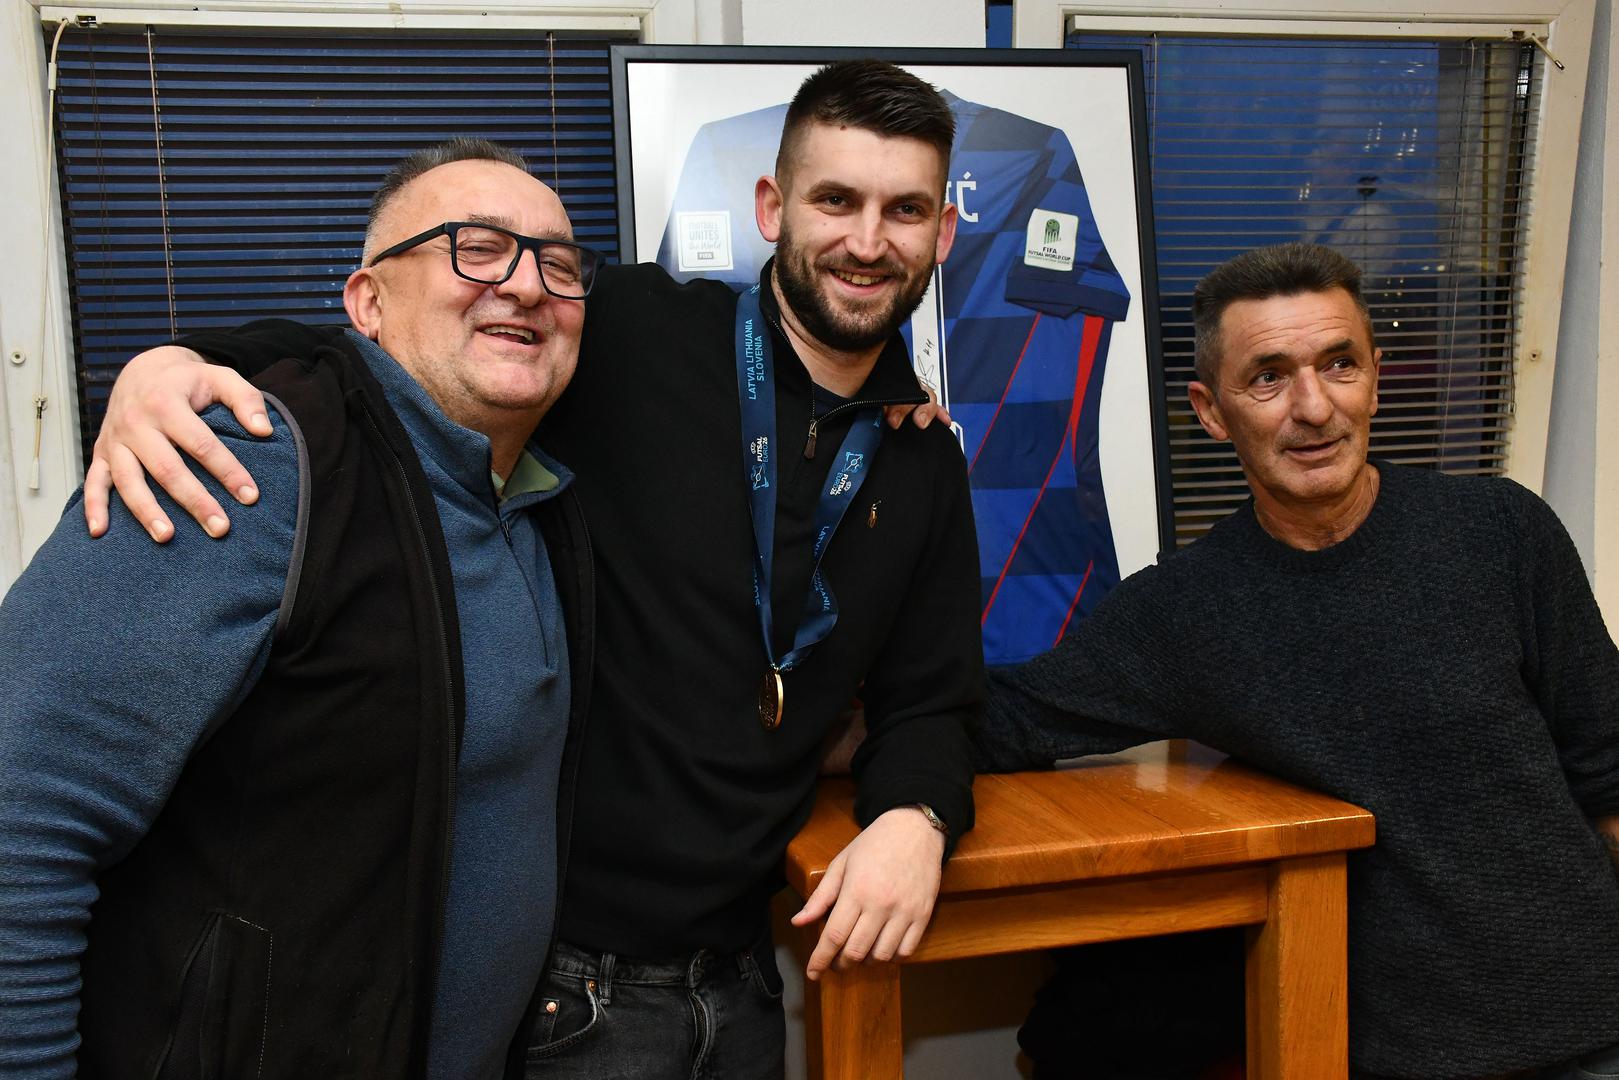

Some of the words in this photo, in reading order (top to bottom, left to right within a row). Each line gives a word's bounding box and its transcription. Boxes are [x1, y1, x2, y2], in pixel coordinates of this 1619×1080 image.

[689, 230, 720, 241] UNITES
[1028, 249, 1044, 257] FUTSAL
[1042, 246, 1057, 254] FIFA
[745, 319, 754, 364] LITHUANIA
[754, 335, 764, 381] SLOVENIA
[748, 366, 756, 400] LATVIA
